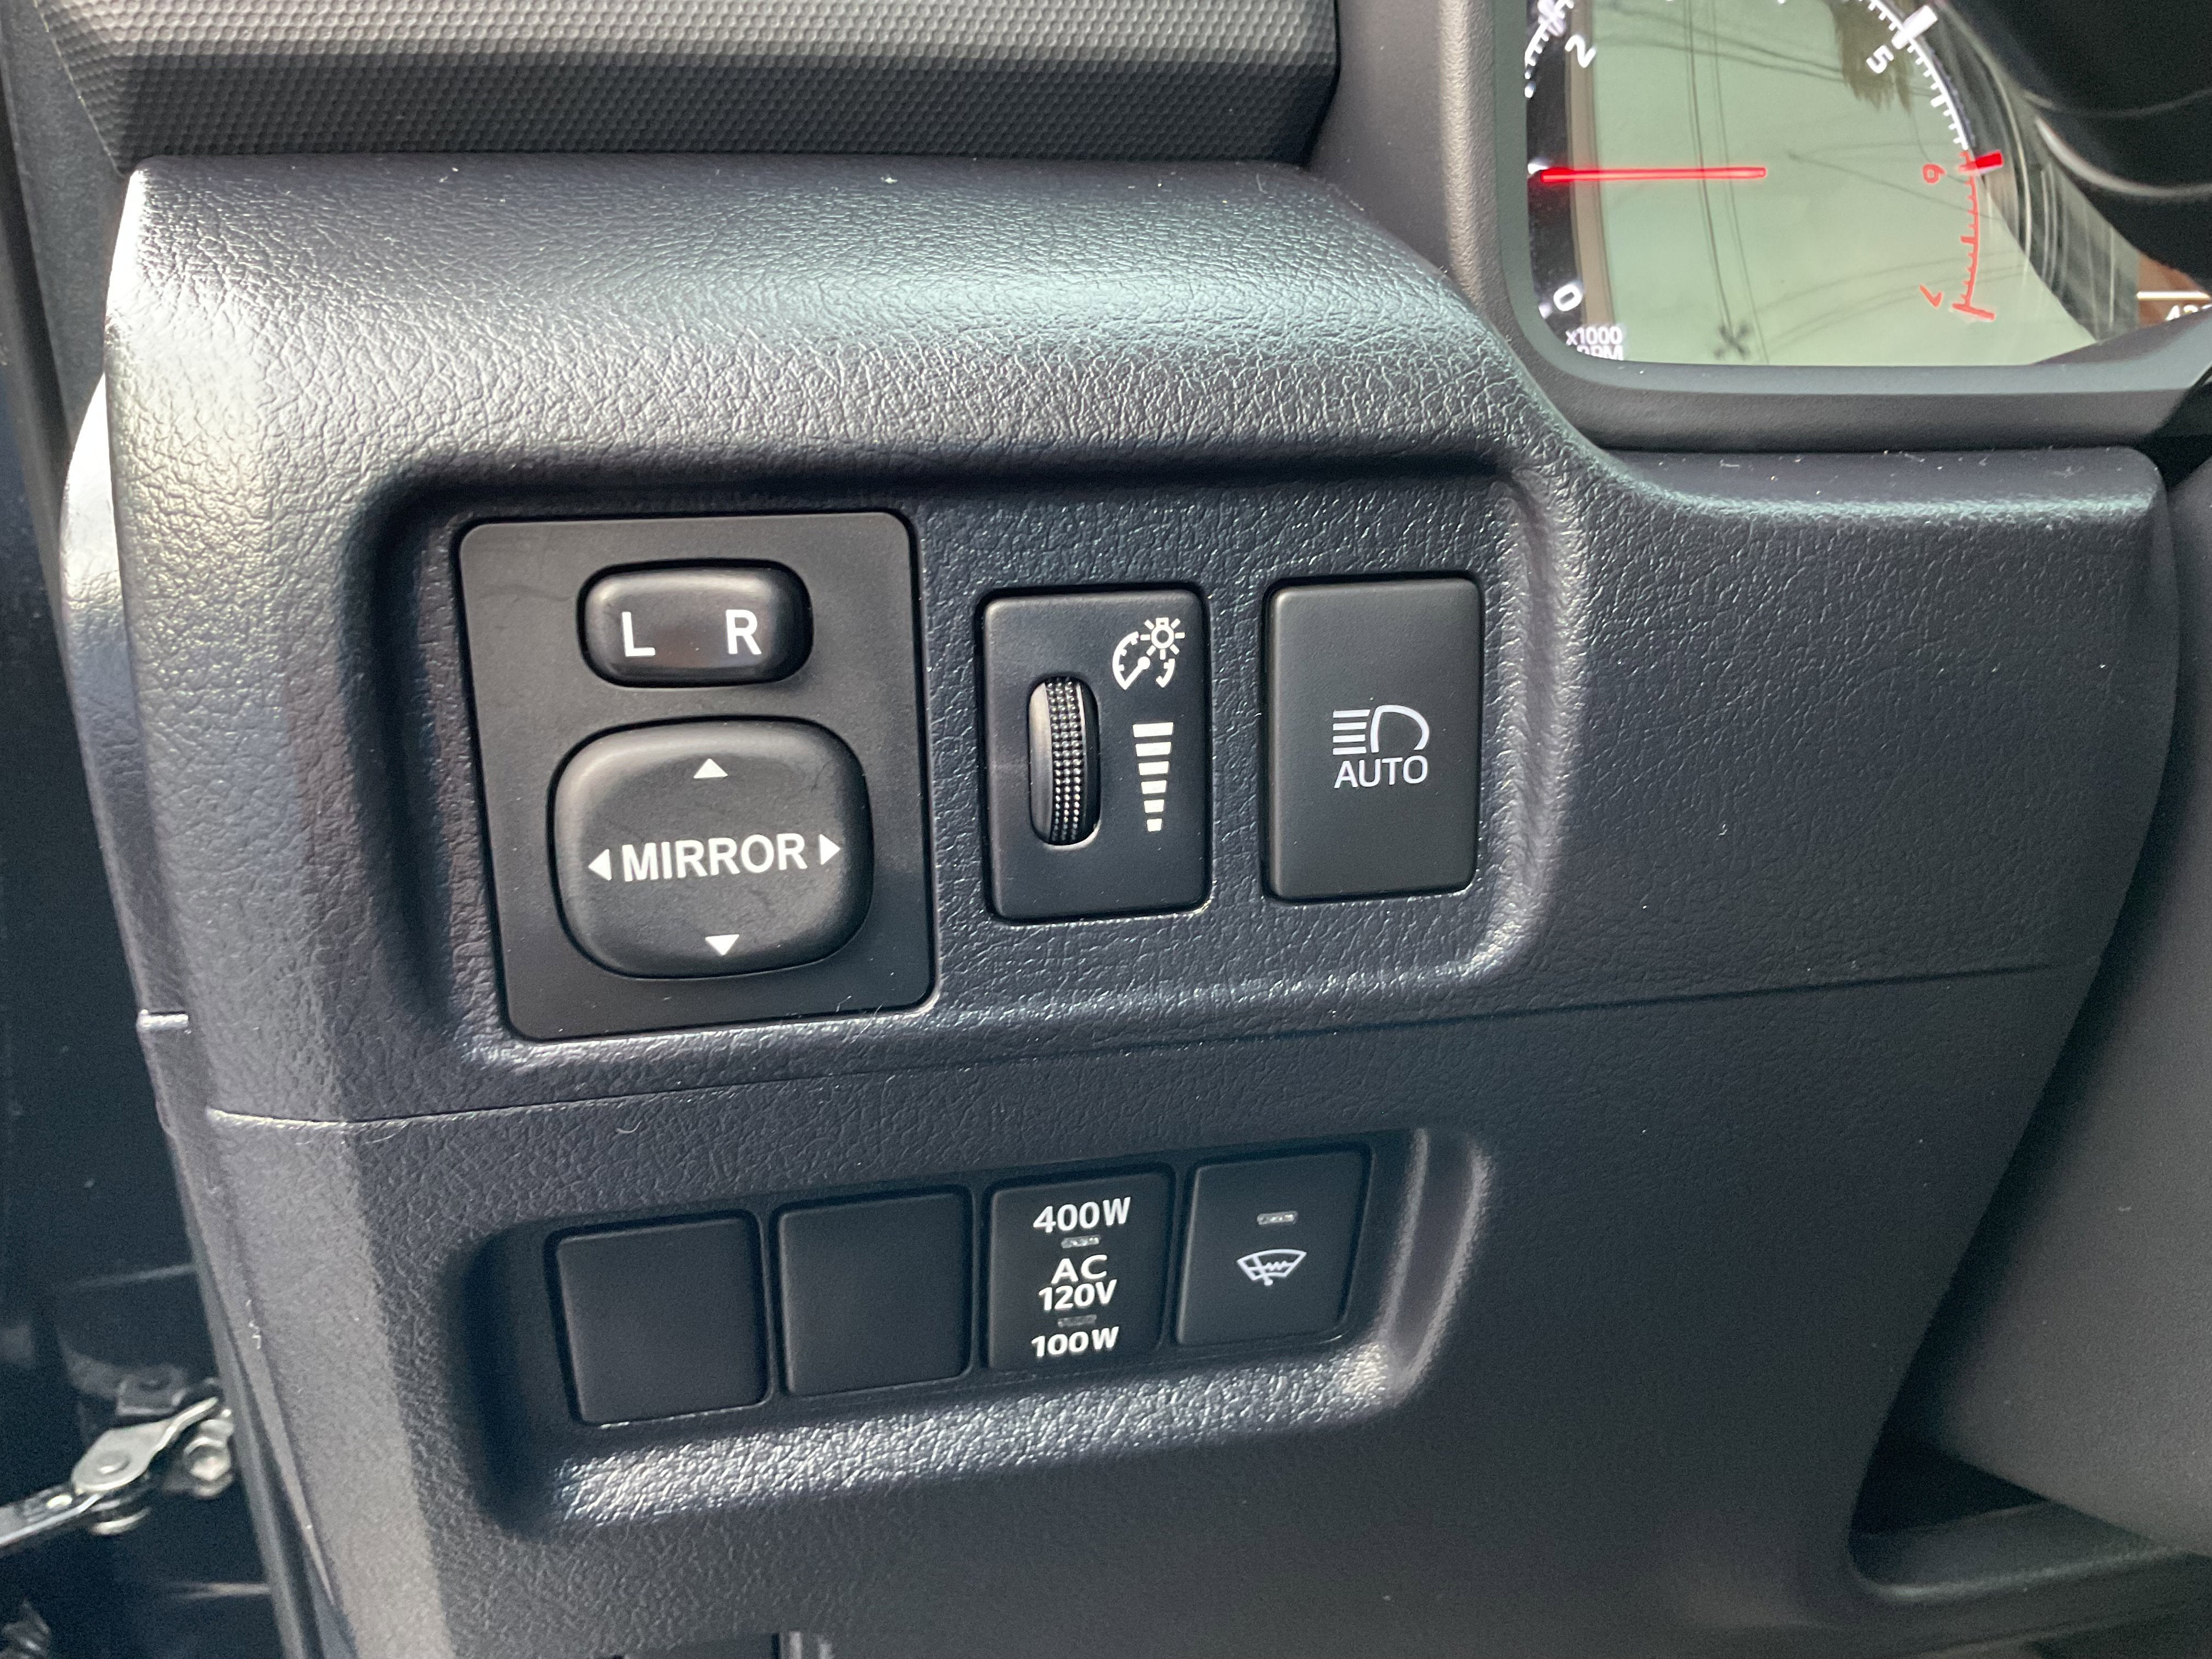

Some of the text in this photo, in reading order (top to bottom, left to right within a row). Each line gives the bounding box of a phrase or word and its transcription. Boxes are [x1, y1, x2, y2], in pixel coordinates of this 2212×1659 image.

[1565, 34, 1597, 68] 2
[1866, 44, 1894, 74] 5
[1922, 163, 1946, 184] 6
[1553, 284, 1582, 312] 0
[1920, 283, 1944, 308] 7
[622, 608, 762, 657] L R
[1333, 754, 1429, 789] AUTO
[621, 832, 808, 882] MIRROR
[1032, 1197, 1131, 1234] 400W
[1050, 1254, 1108, 1285] AC
[1039, 1279, 1118, 1312] 120V
[1031, 1325, 1120, 1358] 100W
